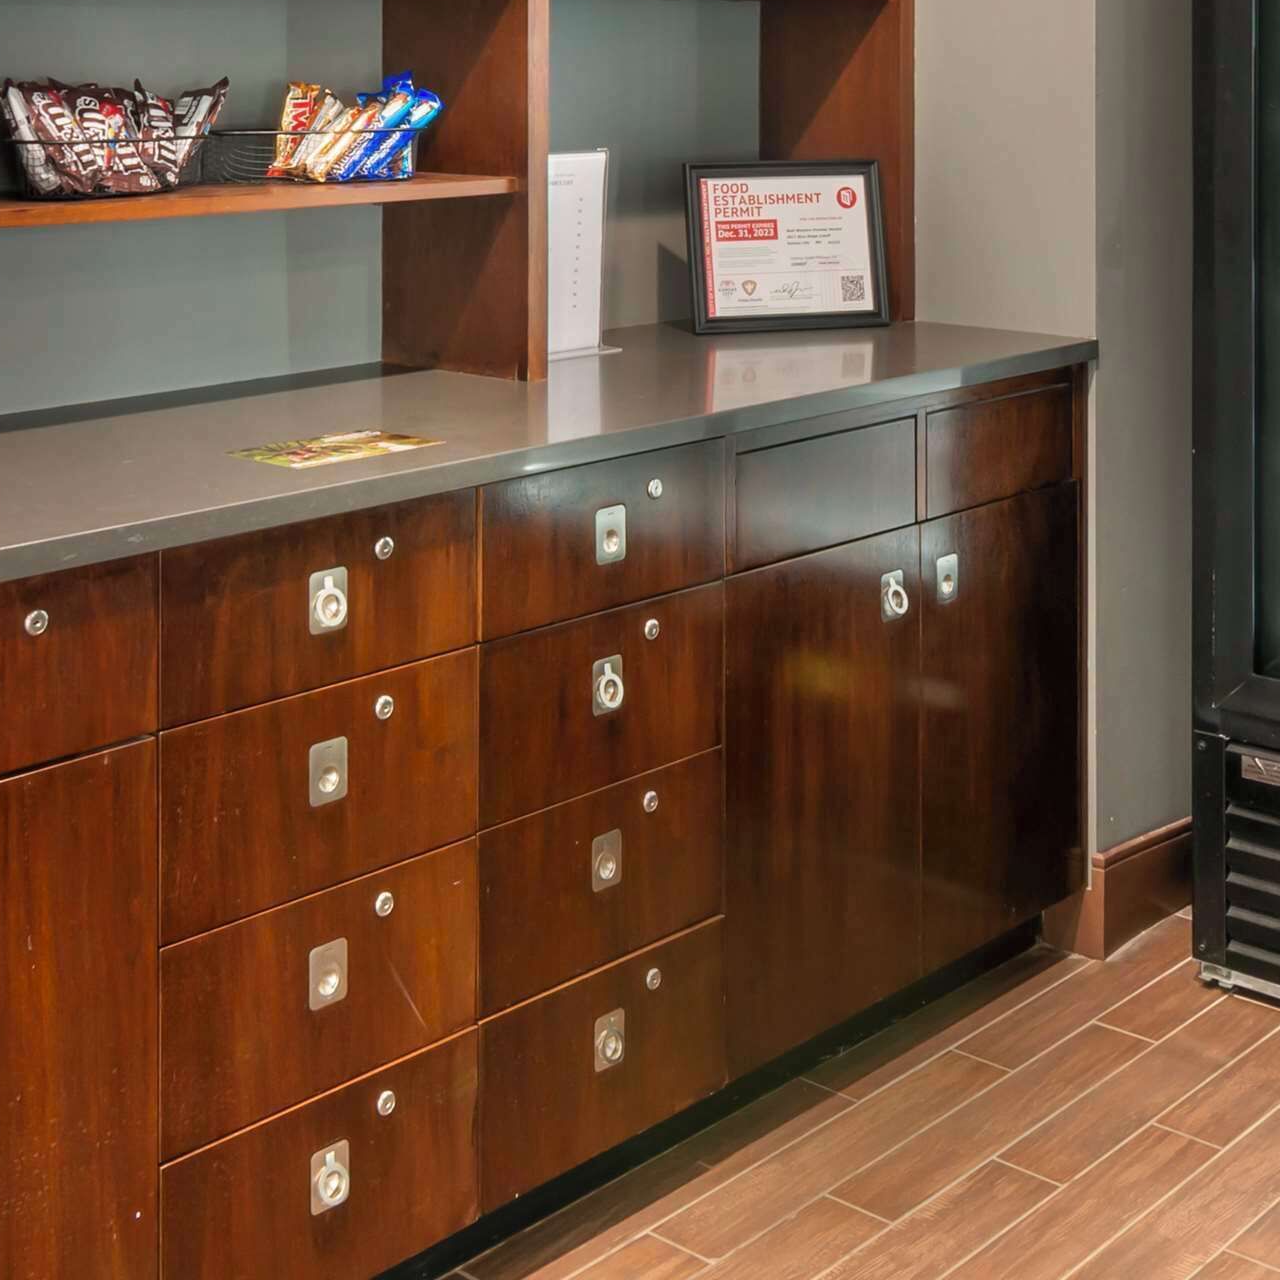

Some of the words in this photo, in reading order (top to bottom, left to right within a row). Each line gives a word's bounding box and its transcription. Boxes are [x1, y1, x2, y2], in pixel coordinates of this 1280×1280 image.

[713, 183, 749, 195] FOOD
[713, 192, 822, 207] ESTABLISHMENT
[714, 206, 763, 218] PERMIT
[718, 229, 737, 238] Dec.
[738, 228, 752, 238] 31,
